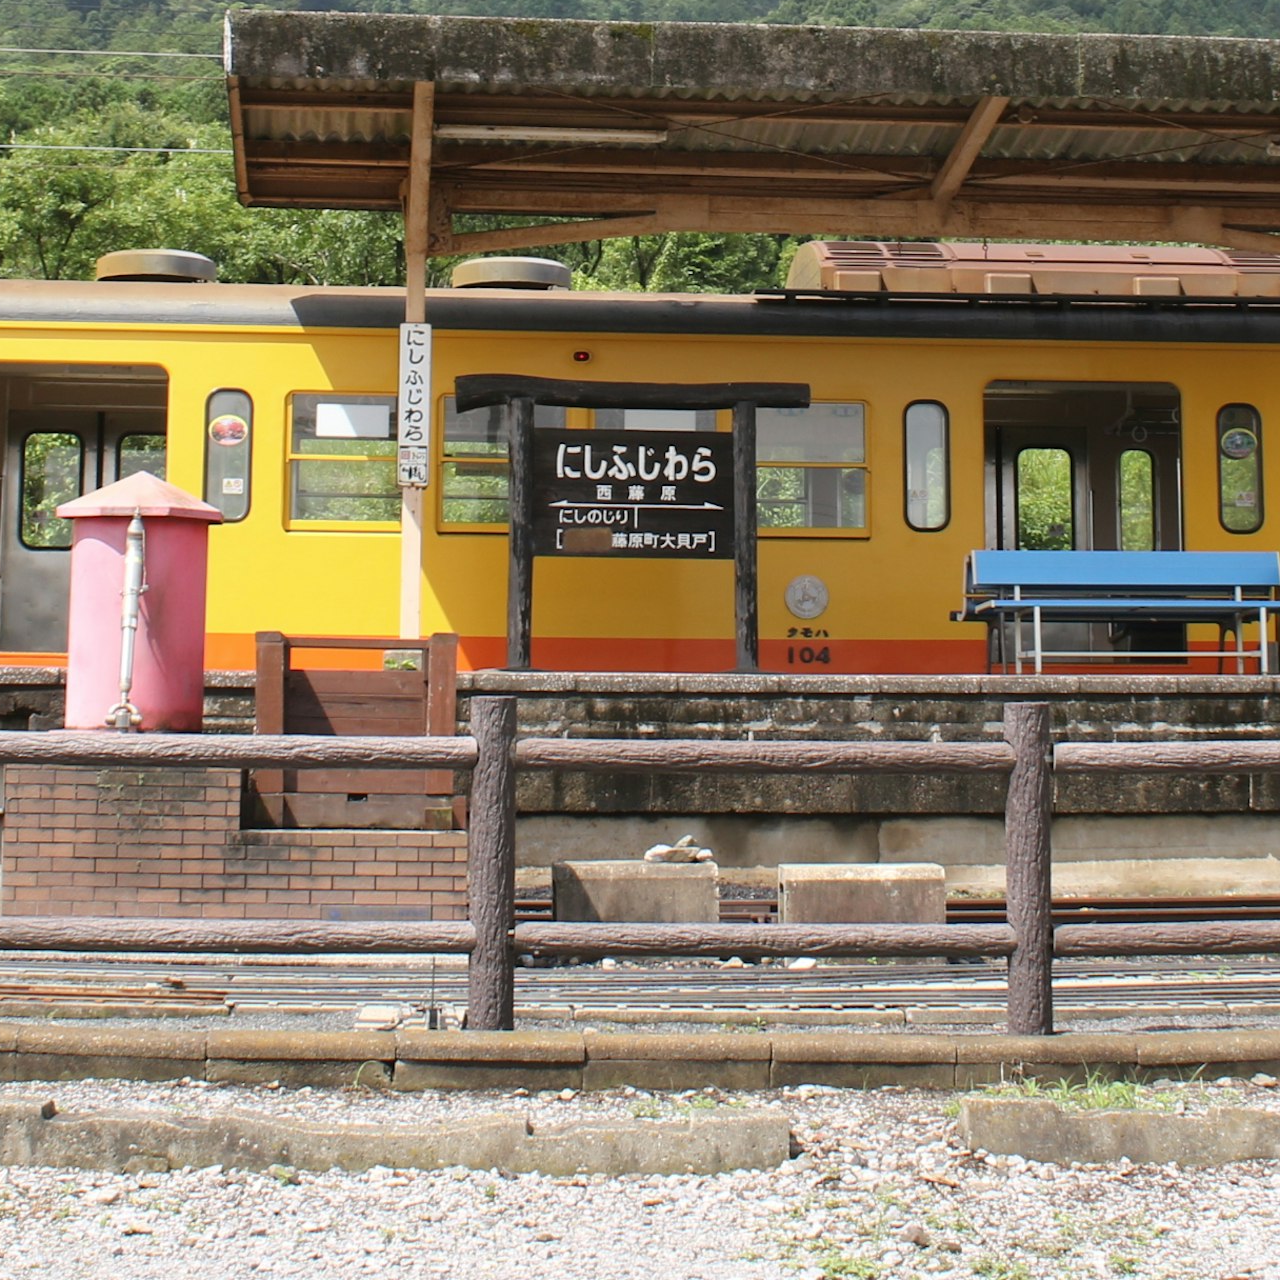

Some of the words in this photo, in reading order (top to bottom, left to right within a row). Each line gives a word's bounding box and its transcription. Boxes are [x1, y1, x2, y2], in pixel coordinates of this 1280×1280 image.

[404, 329, 426, 442] にしふじわら
[556, 443, 717, 483] にしふじわら
[596, 484, 677, 501] 西藤原
[559, 509, 629, 525] にしのじり
[788, 646, 831, 665] 104
